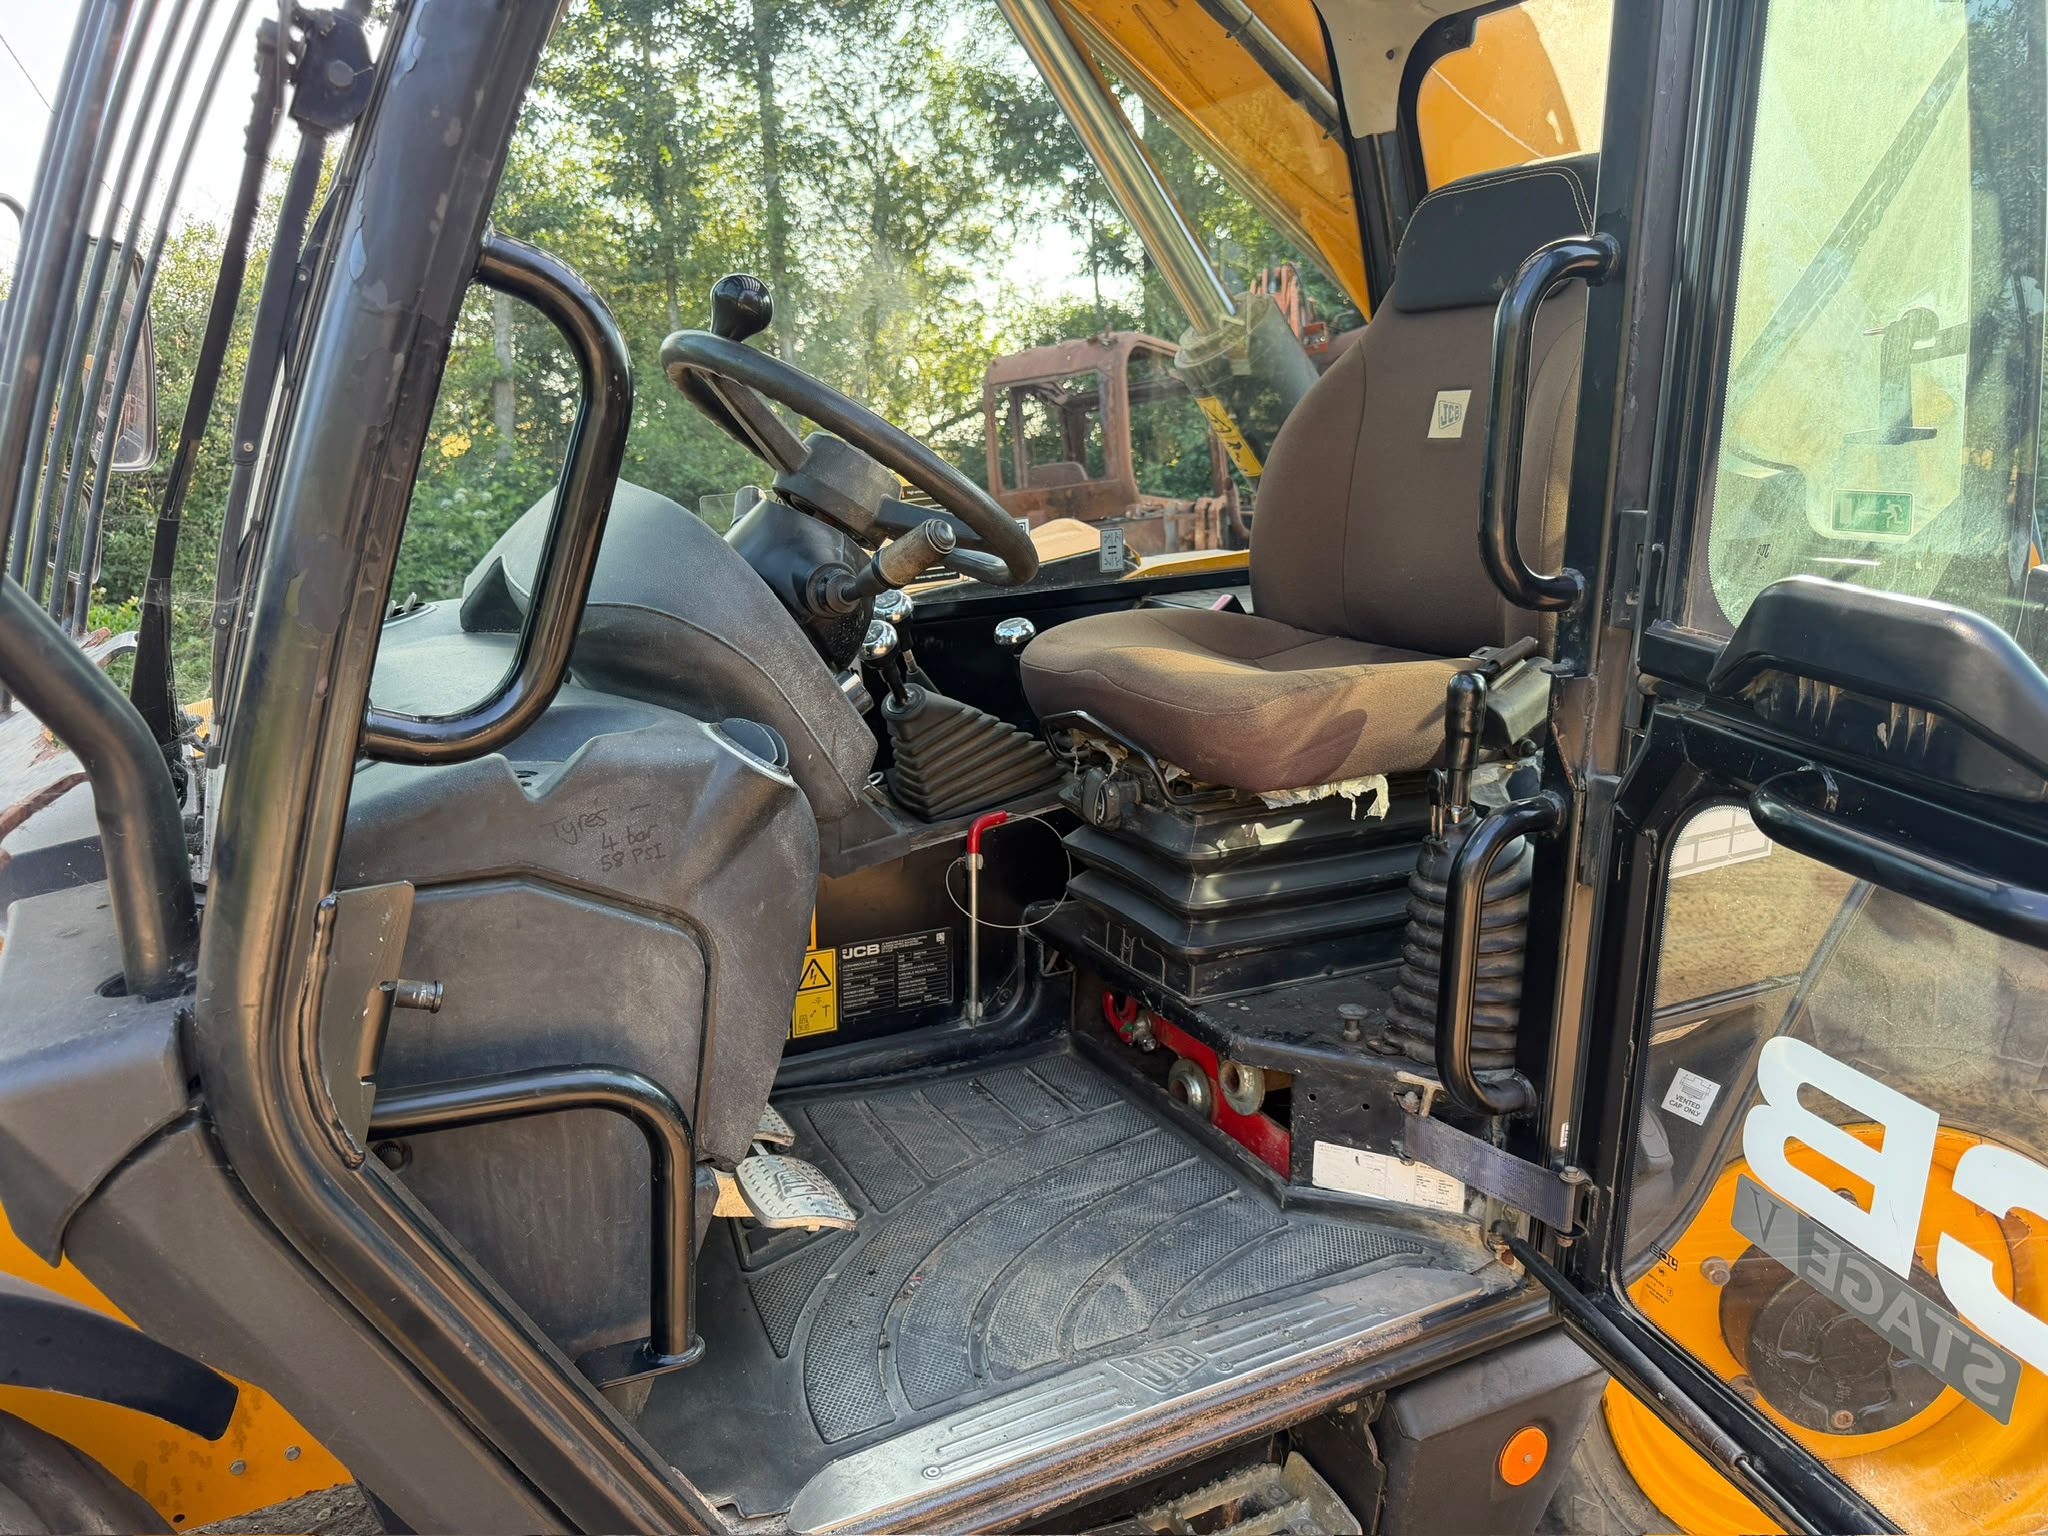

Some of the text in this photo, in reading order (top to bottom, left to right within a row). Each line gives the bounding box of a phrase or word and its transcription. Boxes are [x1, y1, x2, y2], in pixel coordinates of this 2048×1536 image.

[1440, 403, 1460, 427] JCB
[538, 808, 609, 846] Tyres
[602, 824, 659, 852] 4 bar
[600, 842, 667, 873] 58 PSI
[842, 943, 881, 960] JCB
[1668, 1099, 1701, 1117] CAP ONLY
[1675, 1093, 1701, 1110] VENTED
